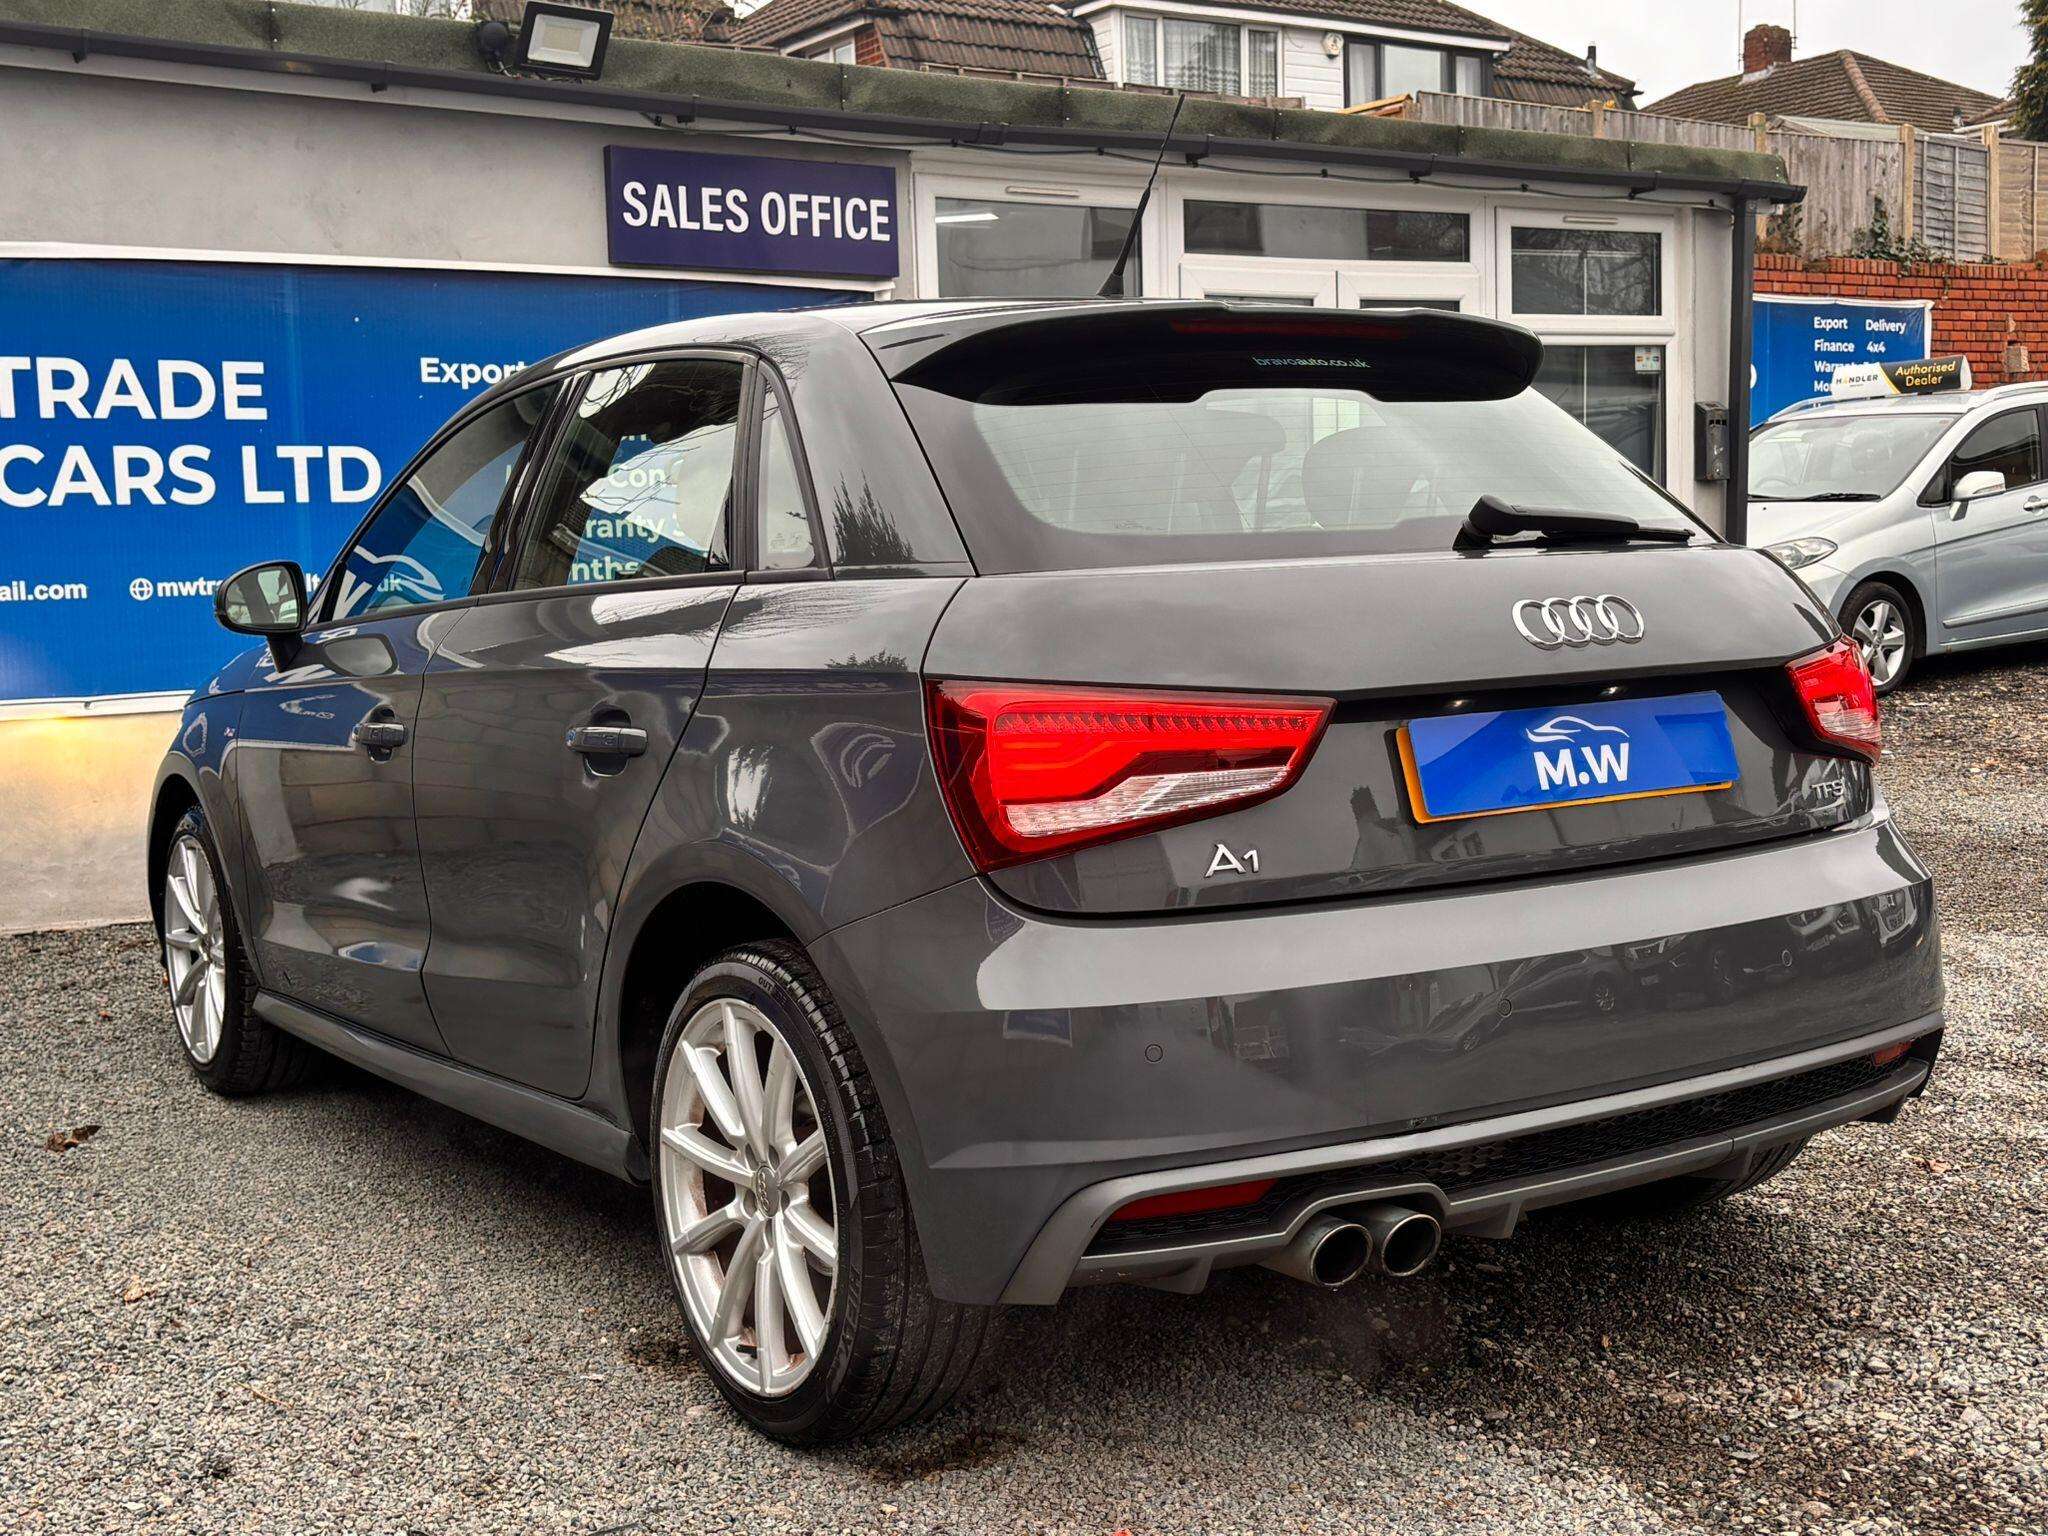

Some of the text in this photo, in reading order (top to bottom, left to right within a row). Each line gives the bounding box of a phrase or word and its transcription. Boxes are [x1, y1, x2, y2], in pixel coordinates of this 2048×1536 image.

[622, 181, 892, 242] SALES OFFICE
[1814, 317, 1848, 331] Export
[1865, 319, 1906, 334] Delivery
[1814, 340, 1855, 352] Finance
[1866, 341, 1886, 353] 4x4
[1252, 357, 1370, 368] bravoauto.co.uk
[1895, 361, 1956, 376] Authorised
[1905, 374, 1943, 387] Dealer
[0, 356, 268, 421] TRADE
[0, 444, 382, 508] CARS LTD
[1533, 742, 1629, 791] M.W
[1205, 843, 1259, 877] A1
